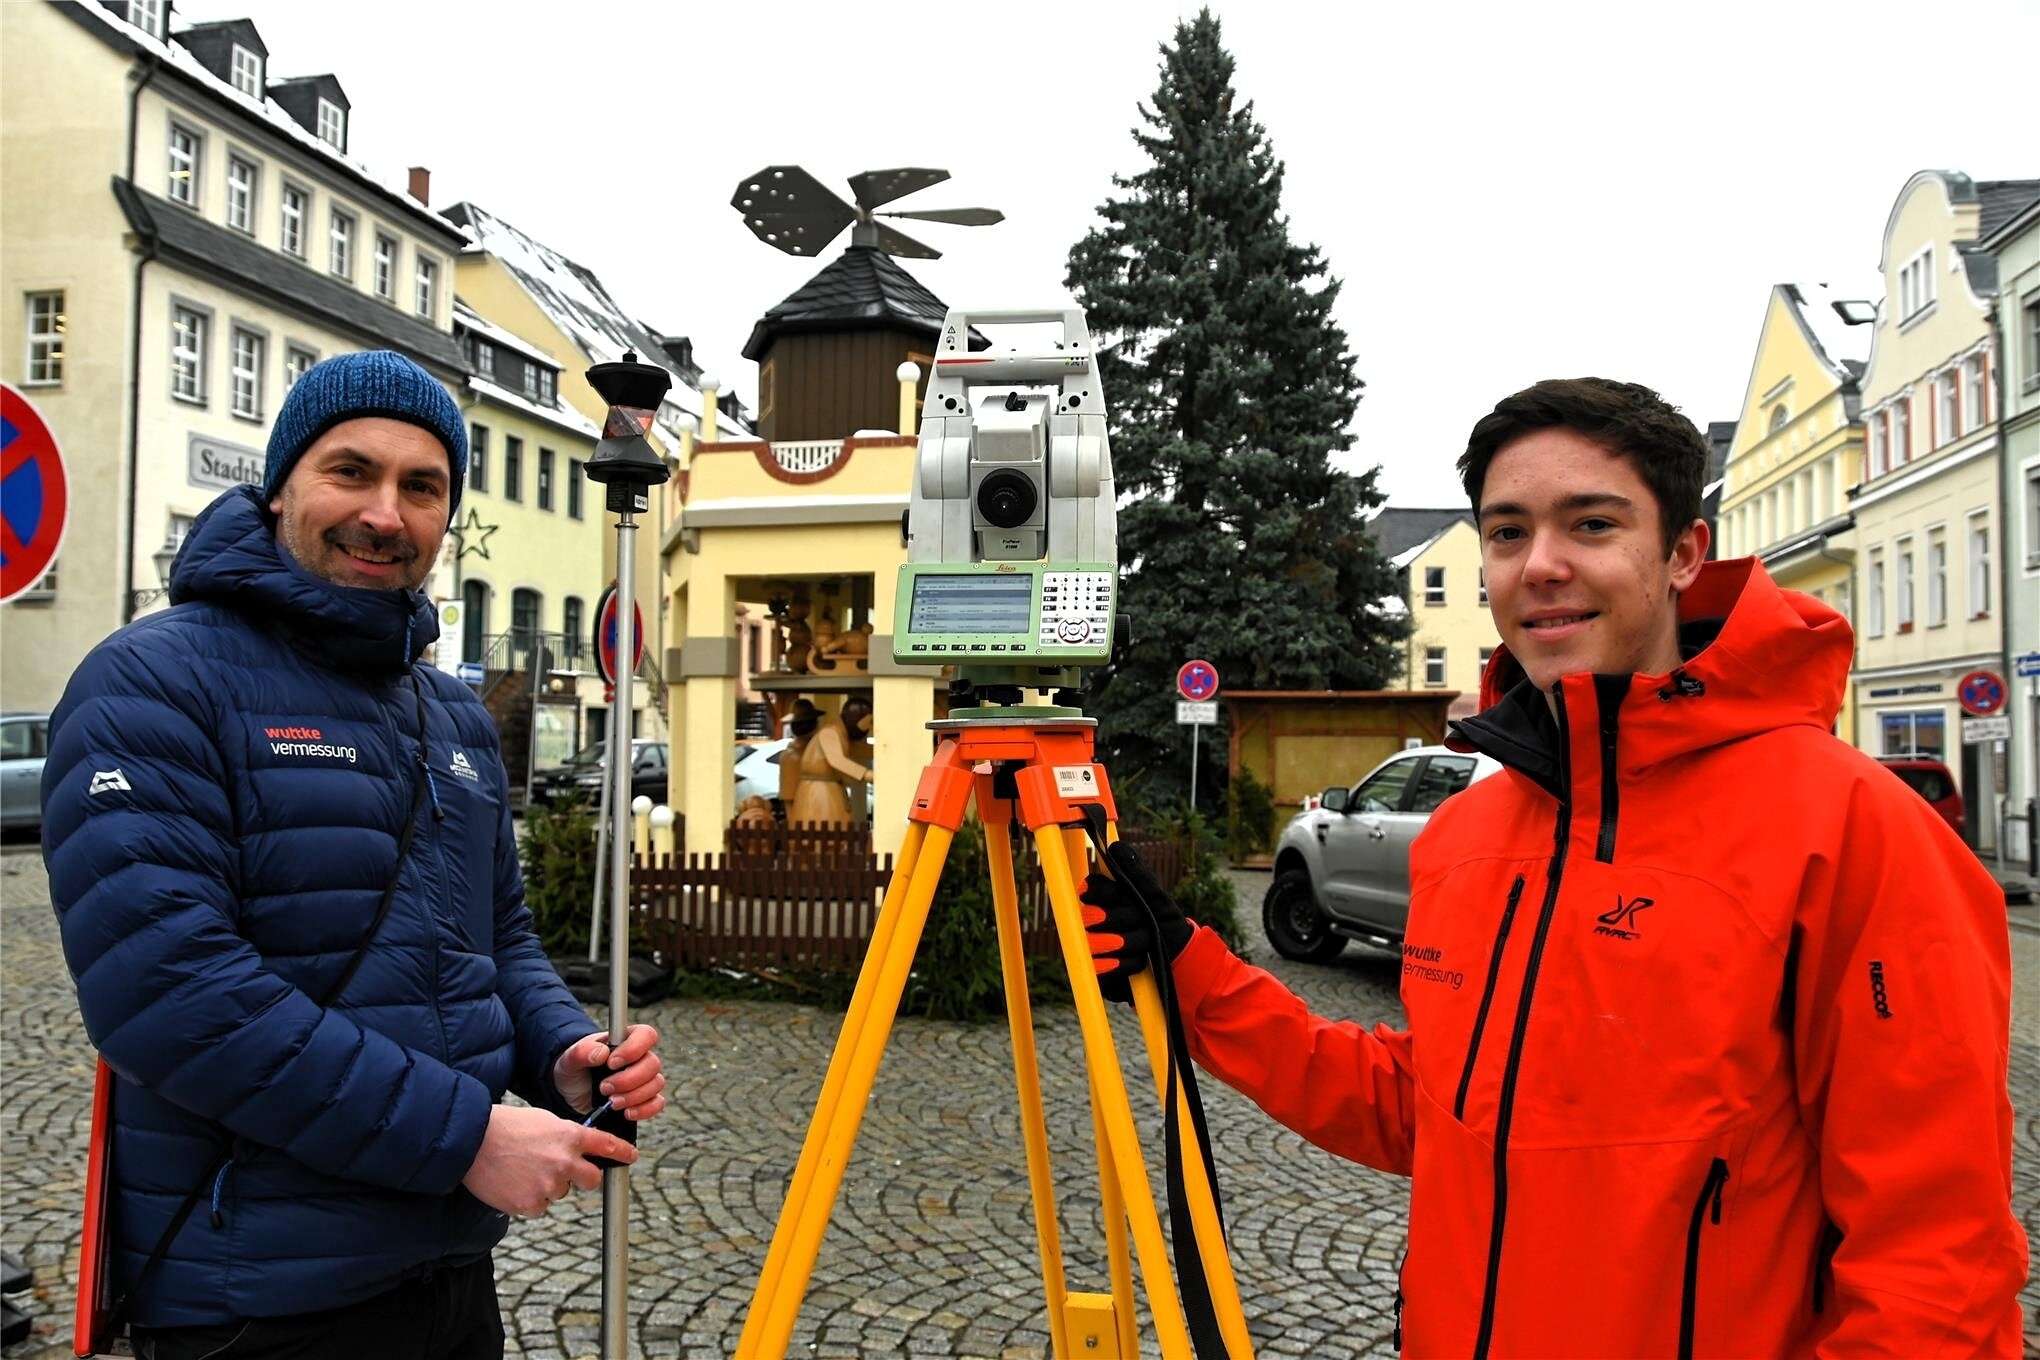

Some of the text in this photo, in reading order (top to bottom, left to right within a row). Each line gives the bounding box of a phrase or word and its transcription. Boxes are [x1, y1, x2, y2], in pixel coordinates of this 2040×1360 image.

[995, 563, 1016, 573] Leica
[264, 727, 322, 740] wuttke
[270, 742, 356, 763] vermessung
[1402, 961, 1464, 990] ermessung
